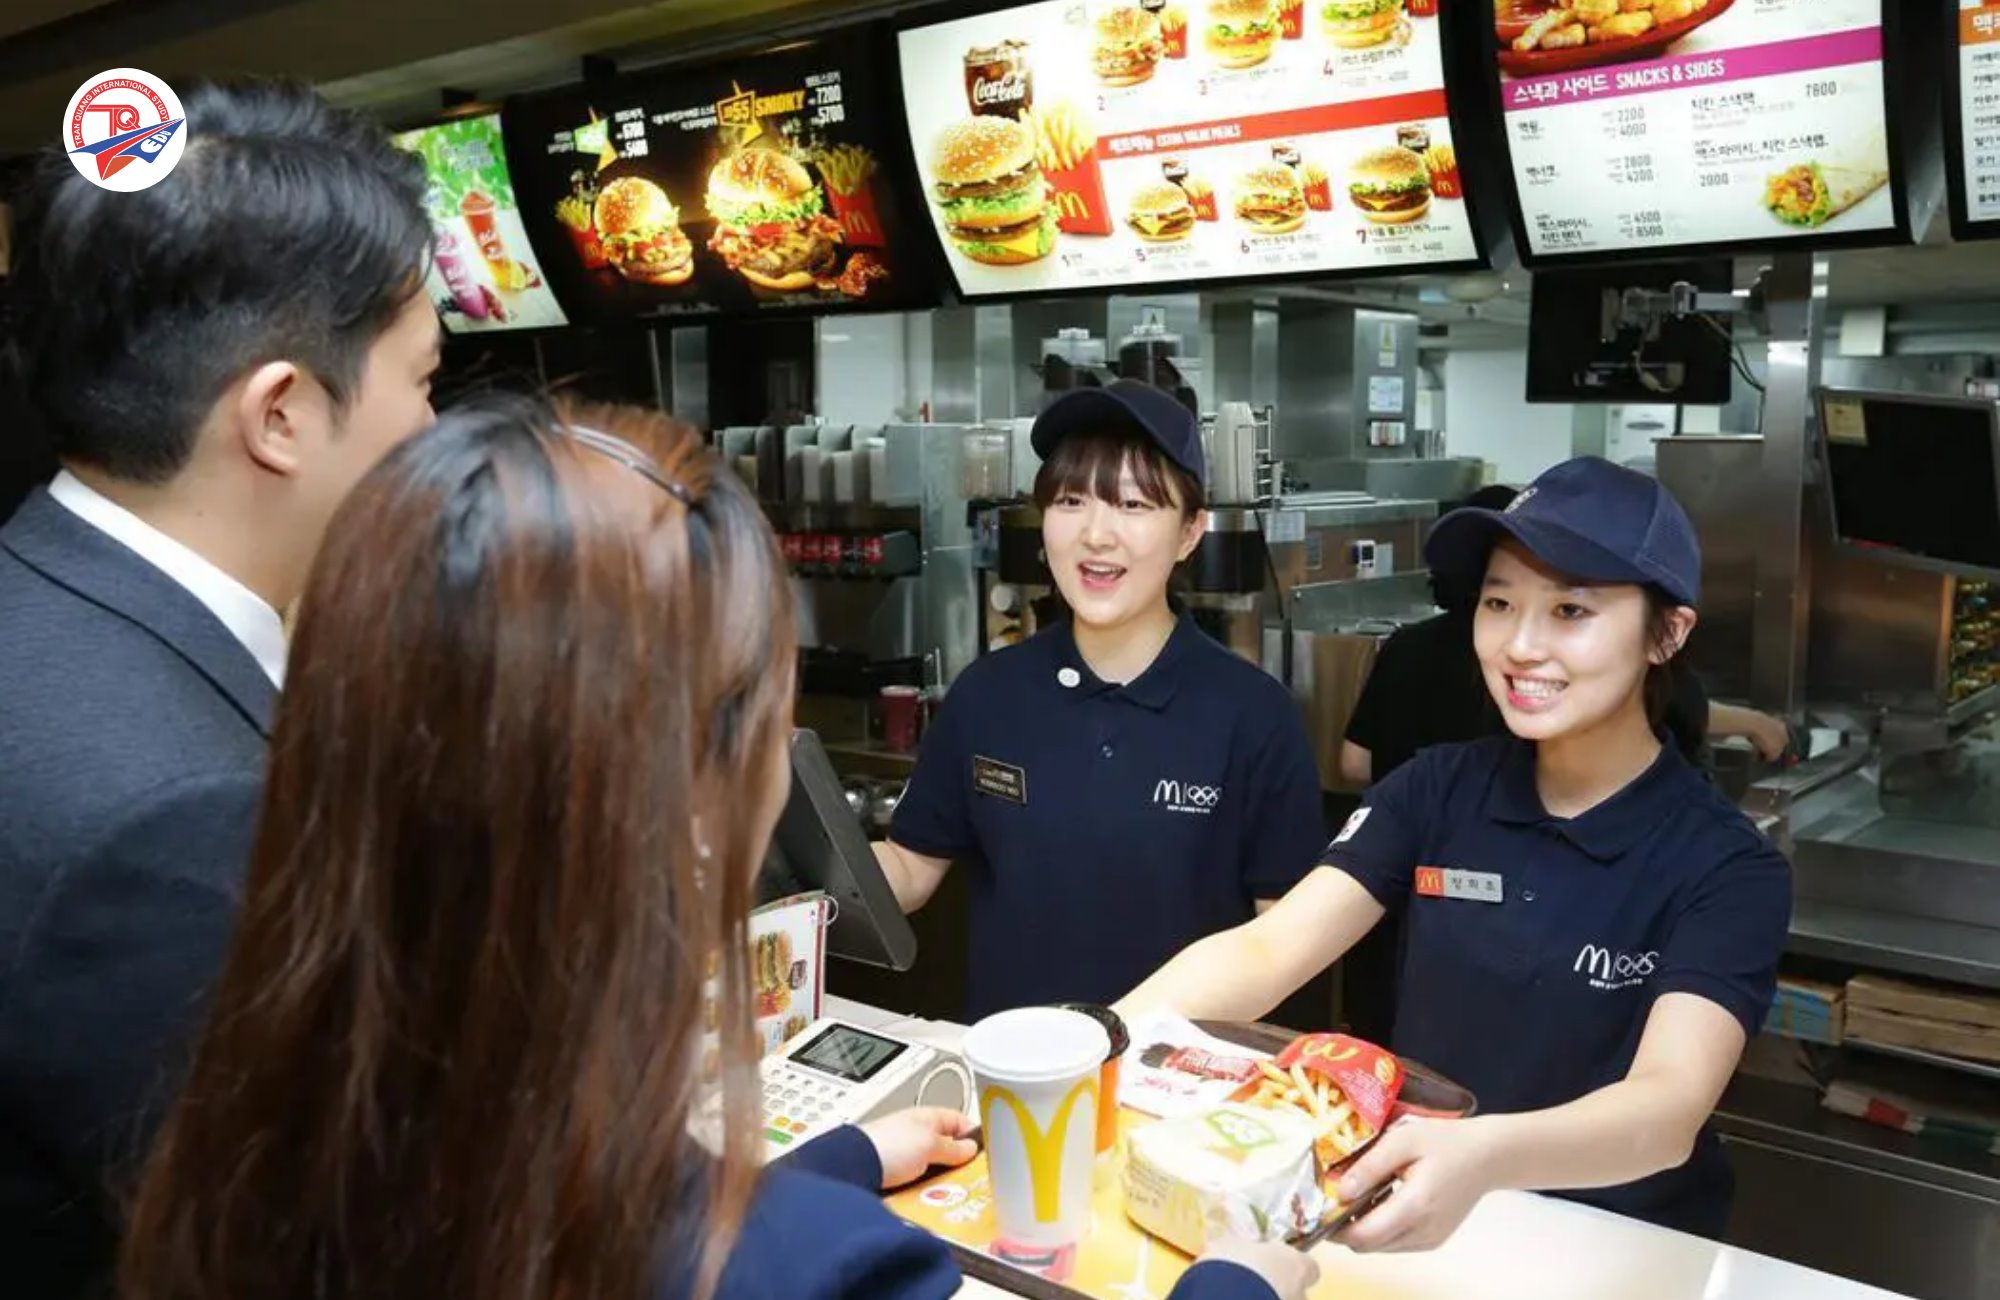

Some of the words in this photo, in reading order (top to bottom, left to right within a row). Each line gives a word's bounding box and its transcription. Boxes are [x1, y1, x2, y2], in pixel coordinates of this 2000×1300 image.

[1513, 80, 1558, 103] 스낵과
[1562, 73, 1611, 96] 사이드
[1616, 67, 1670, 90] SNACKS
[1672, 64, 1684, 82] &
[1685, 58, 1725, 80] SIDES
[755, 90, 807, 117] SMOKY
[1699, 172, 1729, 187] 2000
[1356, 229, 1367, 244] 7
[1241, 239, 1251, 254] 6
[1135, 248, 1147, 263] 5
